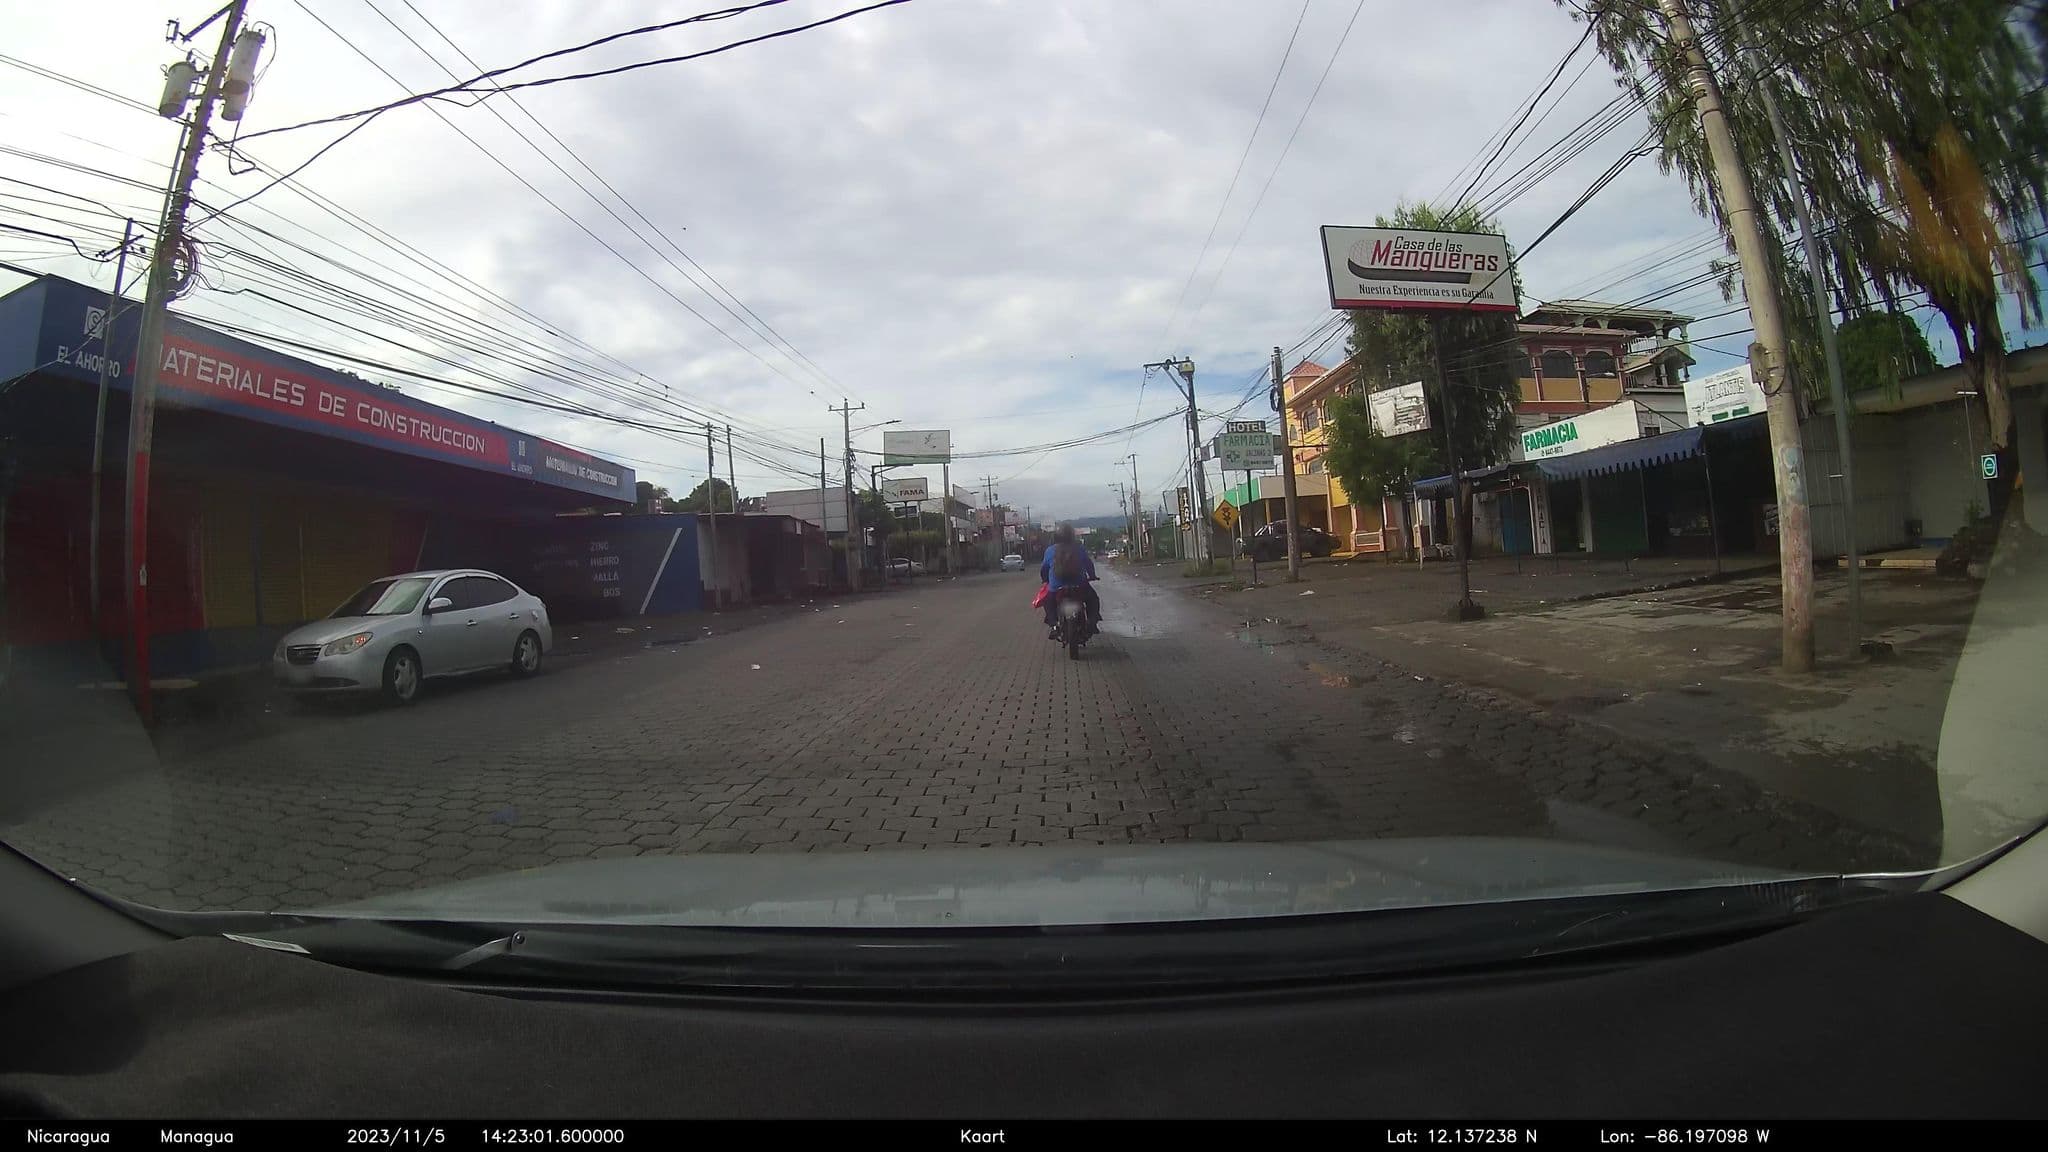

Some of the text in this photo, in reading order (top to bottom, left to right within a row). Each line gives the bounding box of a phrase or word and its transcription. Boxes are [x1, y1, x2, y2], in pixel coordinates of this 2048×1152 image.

[1394, 236, 1463, 253] Casa de las
[1370, 239, 1499, 272] Mangueras
[1359, 284, 1391, 297] Nuestra
[1393, 285, 1440, 298] Experiencia
[1441, 289, 1451, 298] es
[1451, 289, 1461, 298] su
[57, 345, 71, 364] EL
[159, 344, 486, 454] ATERIALES DE CONSTRUCCION
[1228, 422, 1265, 433] HOTEL
[1224, 434, 1271, 447] FARMACIA
[1523, 421, 1578, 453] FARMACIA
